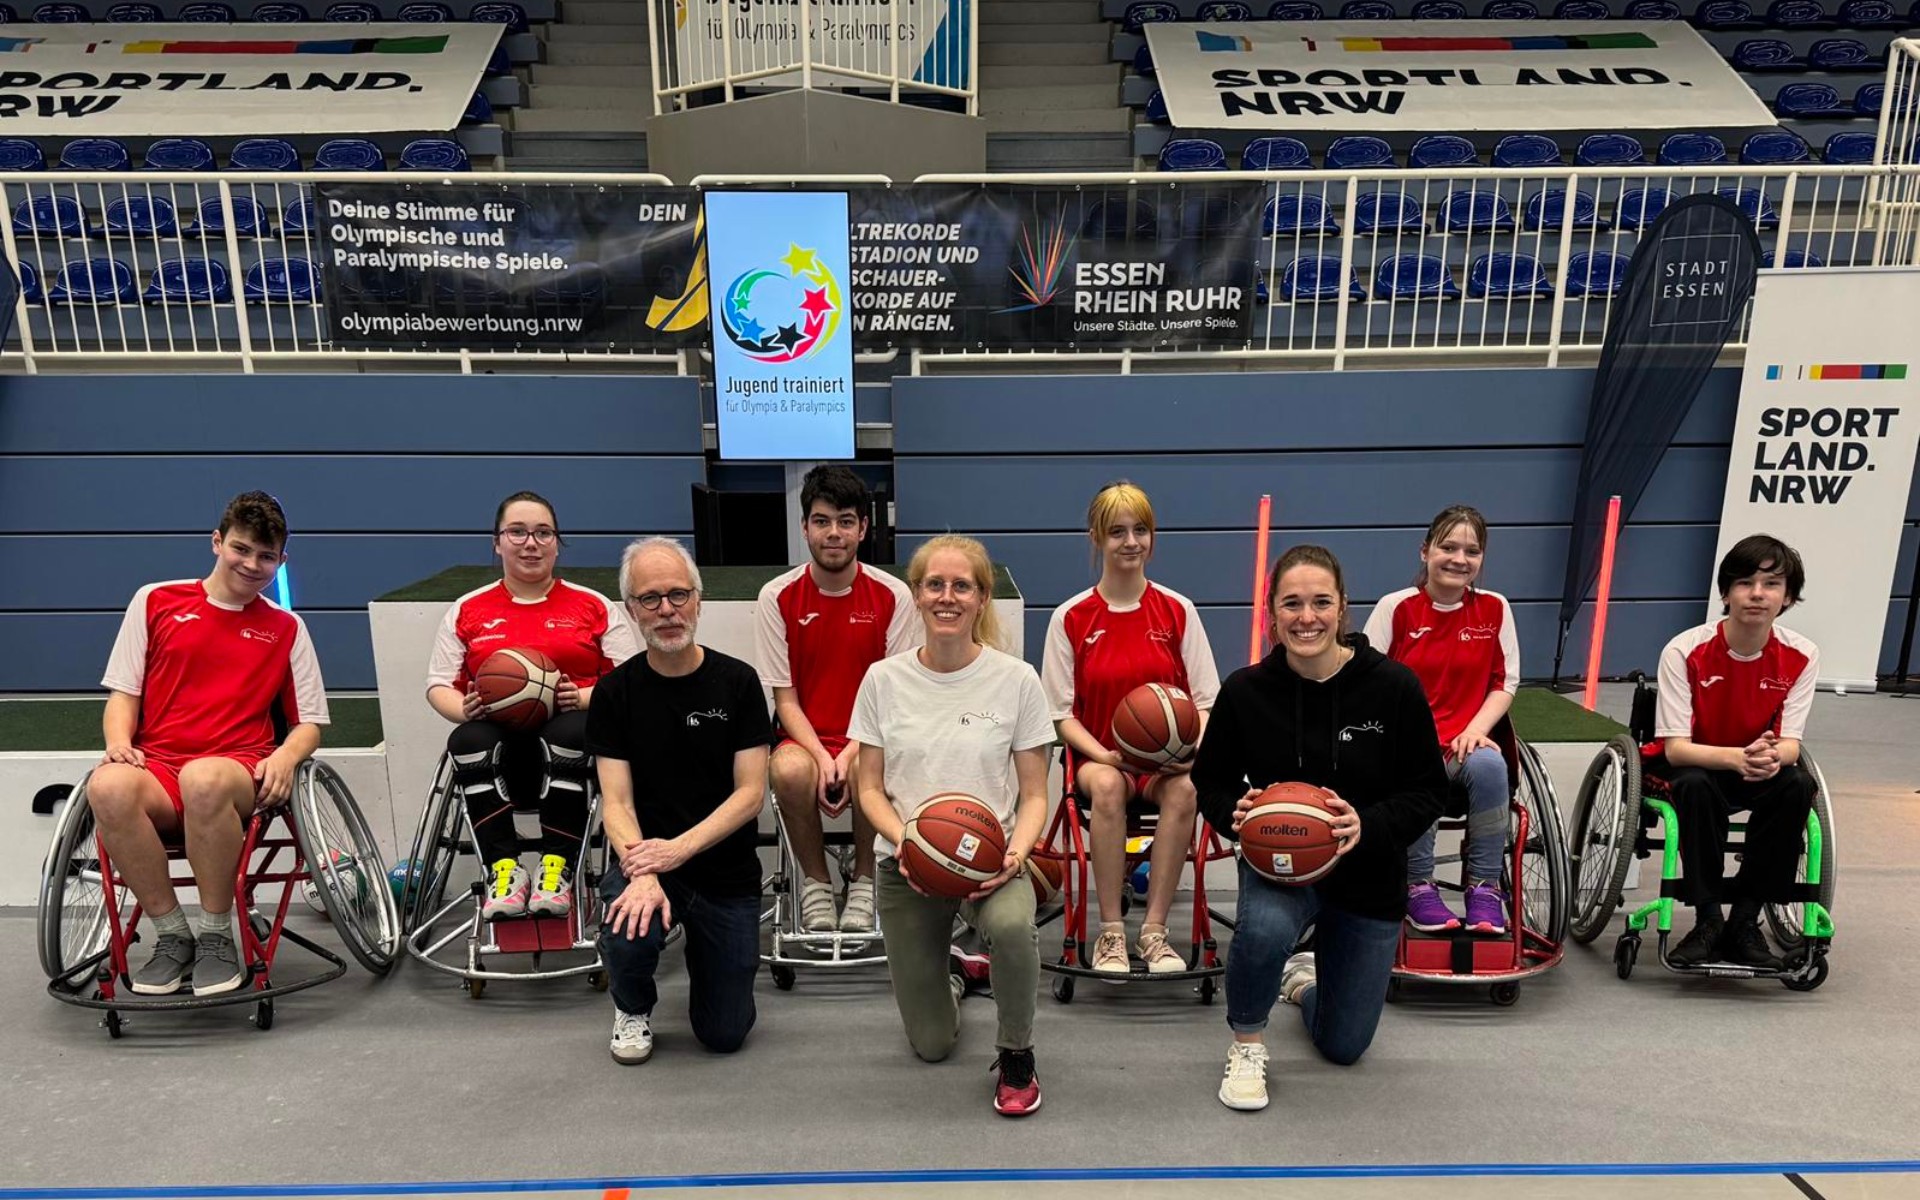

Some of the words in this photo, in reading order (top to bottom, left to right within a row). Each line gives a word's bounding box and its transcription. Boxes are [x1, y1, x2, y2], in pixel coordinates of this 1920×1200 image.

[823, 18, 915, 46] Paralympcs
[0, 71, 423, 92] PORTLAND.
[0, 94, 122, 118] RW
[1220, 91, 1405, 117] NRW
[328, 199, 391, 220] Deine
[396, 202, 479, 222] Stimme
[483, 203, 516, 222] für
[638, 203, 687, 222] DEIN
[331, 224, 457, 246] Olympische
[462, 228, 505, 247] und
[851, 222, 961, 241] LTREKORDE
[334, 248, 491, 272] Paralympische
[496, 252, 569, 275] Spiele.
[937, 247, 980, 265] UND
[852, 269, 947, 287] SCHAUER-
[1075, 262, 1166, 286] ESSEN
[1665, 260, 1728, 277] STADT
[852, 292, 916, 310] KORDE
[918, 292, 957, 310] AUF
[1074, 290, 1157, 314] RHEIN
[1166, 286, 1242, 312] RUHR
[1663, 281, 1725, 299] ESSEN
[341, 312, 583, 336] olympiabewerbung.nrw
[870, 310, 955, 332] RÄNGEN.
[1073, 320, 1115, 332] Unsere
[1117, 319, 1158, 332] Städte.
[1161, 318, 1201, 330] Unsere
[1205, 316, 1239, 330] Spiele.
[725, 375, 778, 398] Jugend
[784, 375, 845, 394] trainiert
[726, 399, 739, 413] für
[741, 399, 778, 416] Olympia
[780, 400, 788, 413] &
[790, 400, 846, 416] Paralympics
[1758, 407, 1900, 437] SPORT
[1754, 441, 1875, 471] LAND.
[1749, 475, 1853, 504] NRW
[954, 806, 997, 833] molten
[1260, 823, 1309, 837] molten
